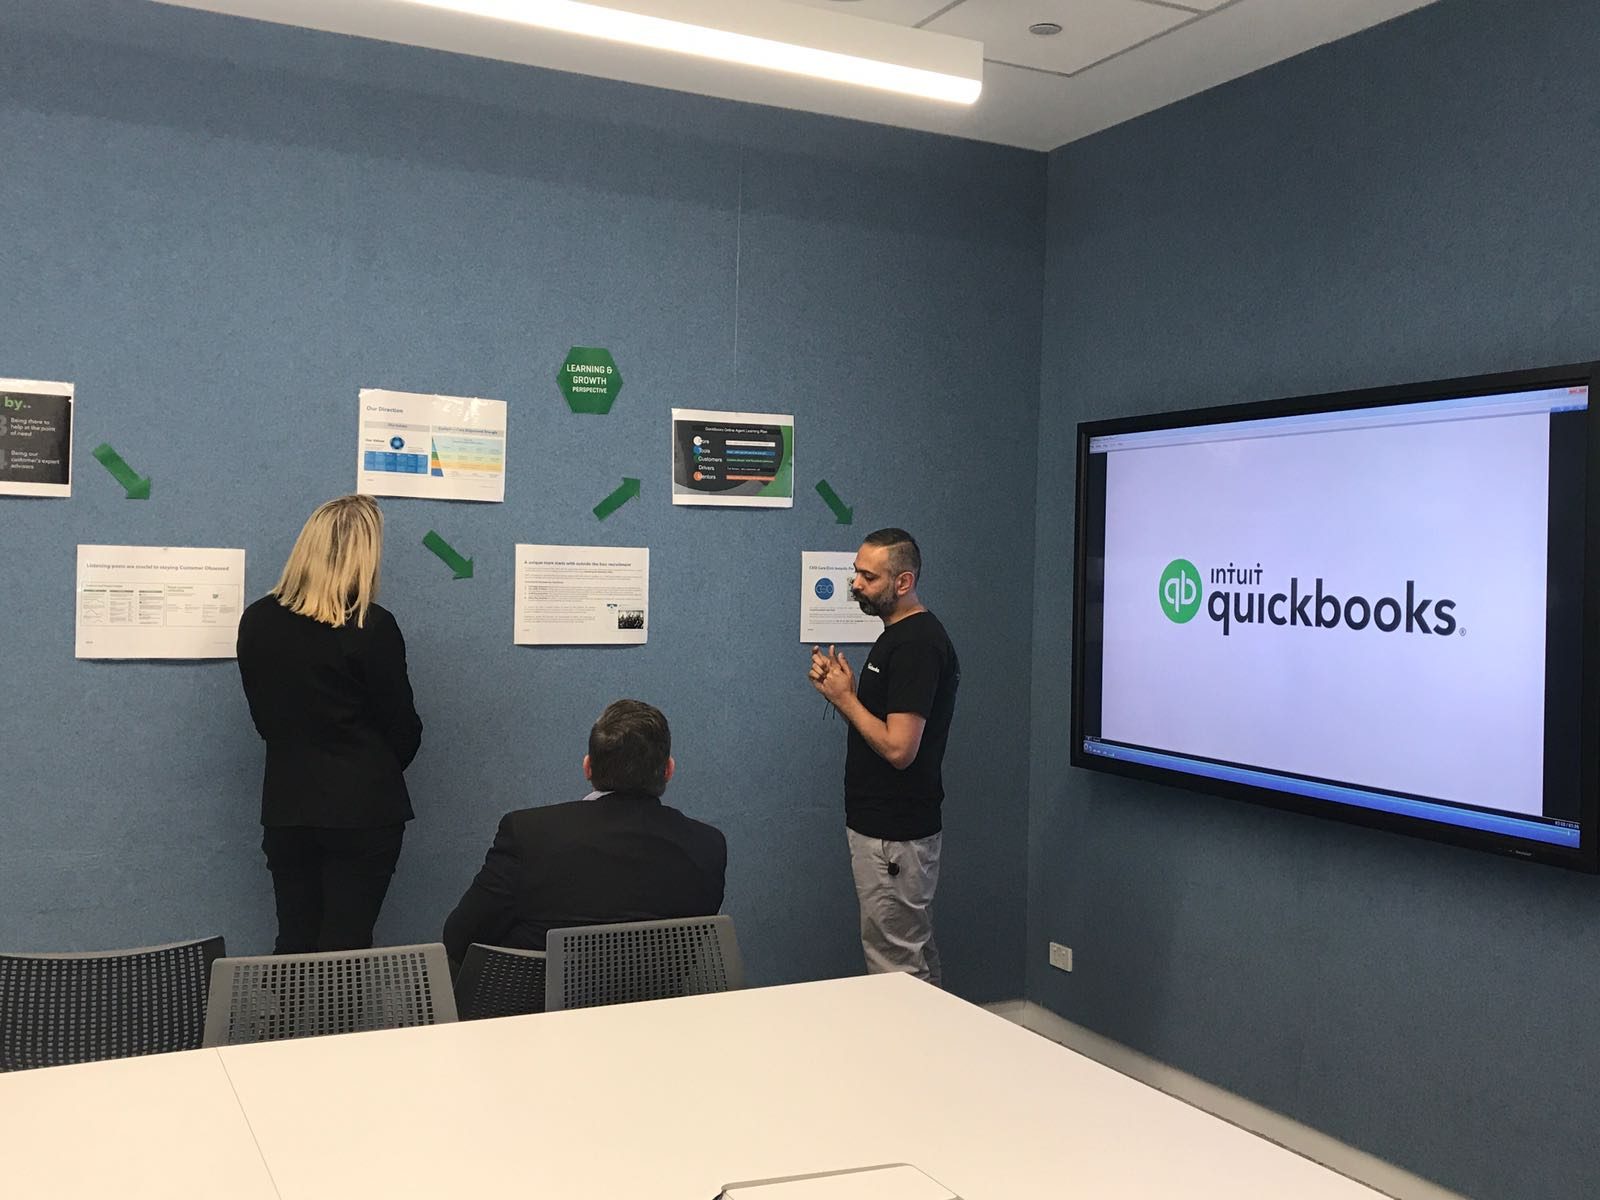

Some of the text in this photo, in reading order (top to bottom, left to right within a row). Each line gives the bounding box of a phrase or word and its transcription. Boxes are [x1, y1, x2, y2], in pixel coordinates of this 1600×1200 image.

[566, 364, 612, 374] LEARNING &
[572, 376, 607, 384] GROWTH
[1211, 562, 1263, 585] intuit
[1208, 578, 1456, 636] quickbooks
